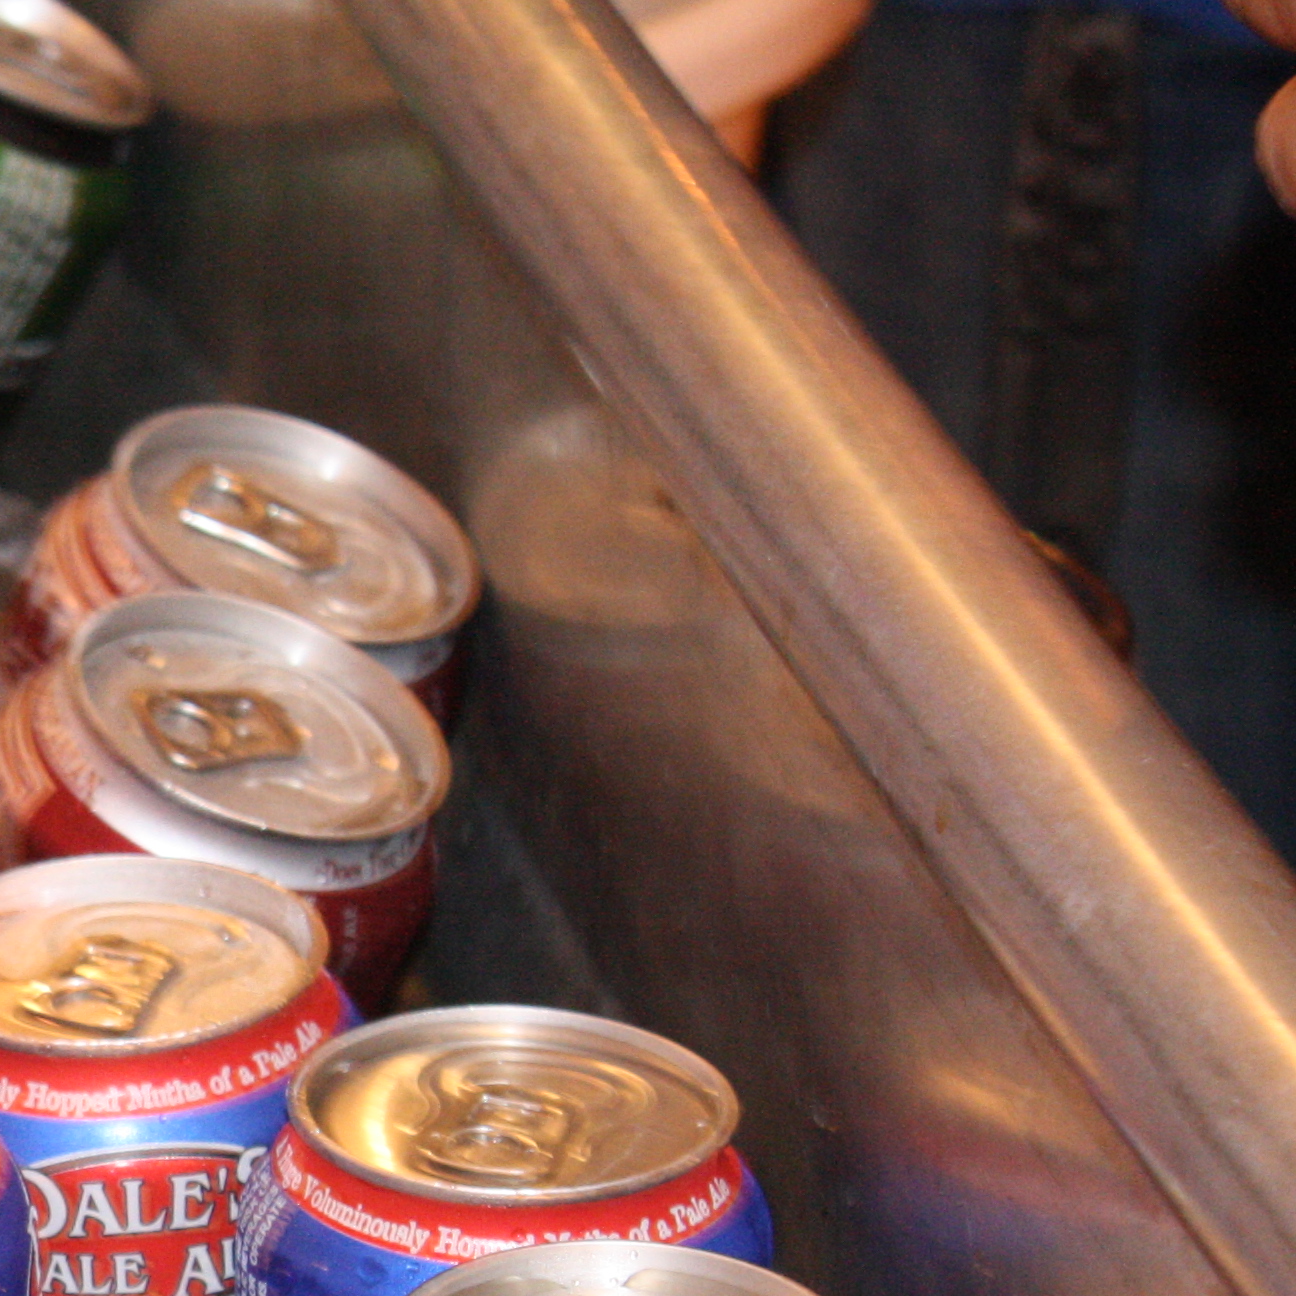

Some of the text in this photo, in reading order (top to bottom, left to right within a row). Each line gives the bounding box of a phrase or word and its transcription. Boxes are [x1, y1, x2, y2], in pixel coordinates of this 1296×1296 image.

[24, 1020, 323, 1116] Hopped Mutha of a Pale Ale
[303, 1175, 730, 1252] Voluminously Pale Ale
[42, 1251, 150, 1296] ALE
